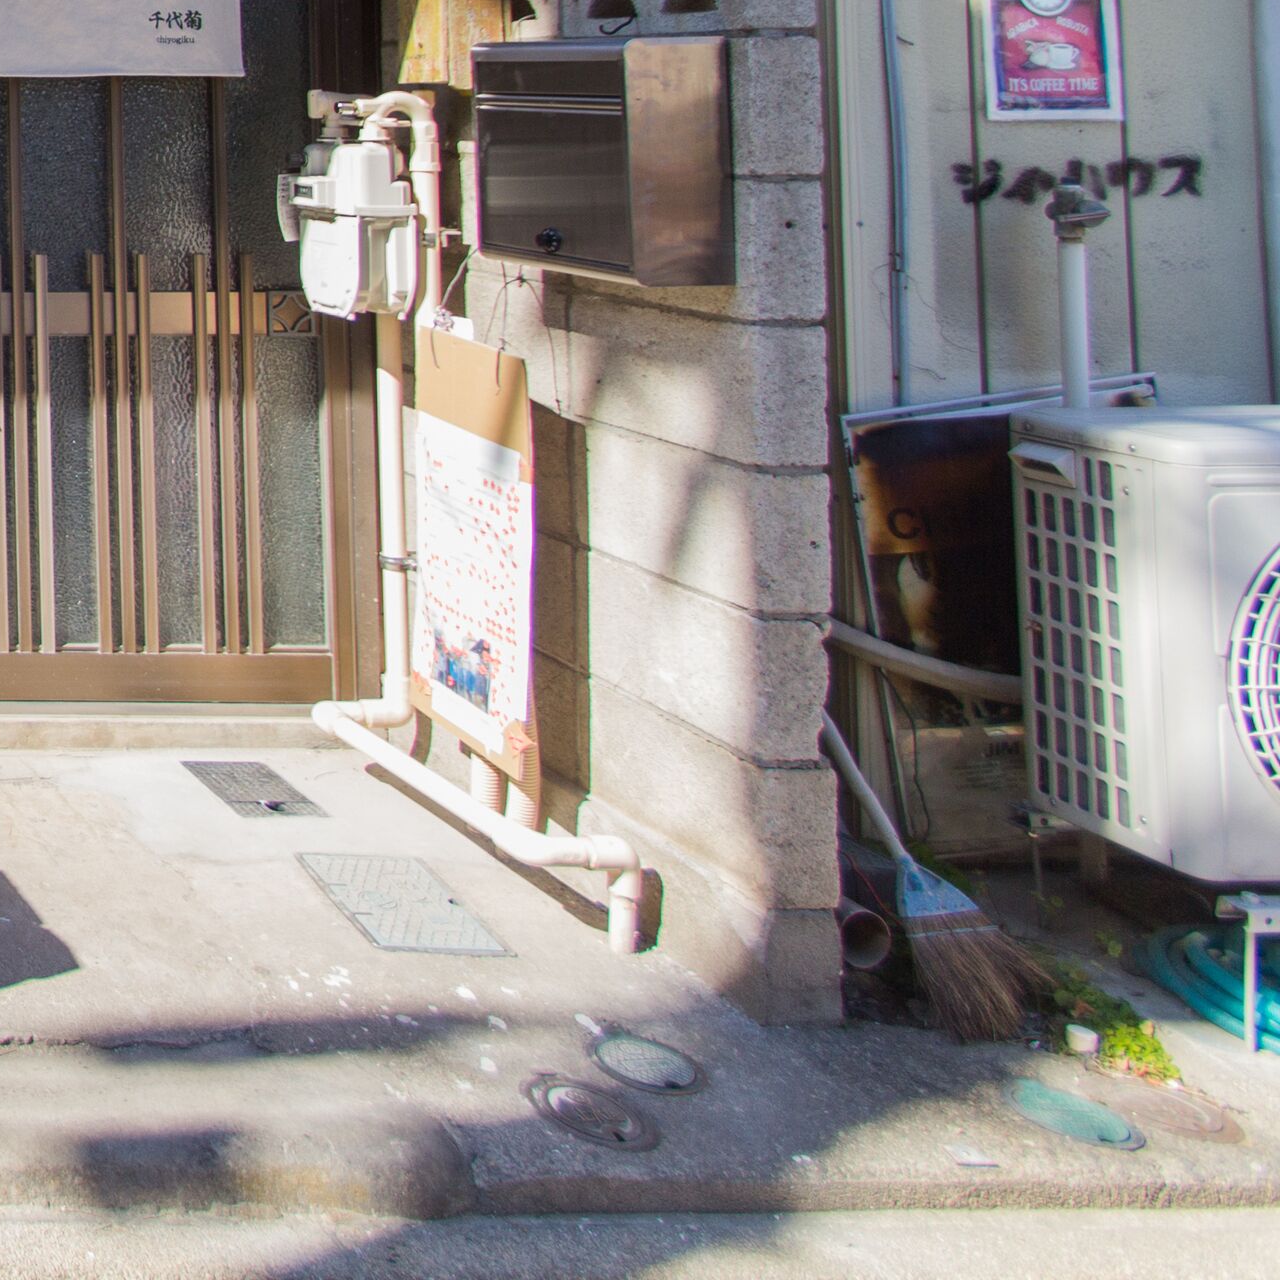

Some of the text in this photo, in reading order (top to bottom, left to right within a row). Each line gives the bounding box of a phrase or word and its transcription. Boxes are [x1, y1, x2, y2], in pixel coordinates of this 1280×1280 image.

[148, 10, 203, 31] 千代菊
[156, 35, 196, 45] chiyogiku
[1008, 77, 1099, 92] IT'S COFFEE TIME
